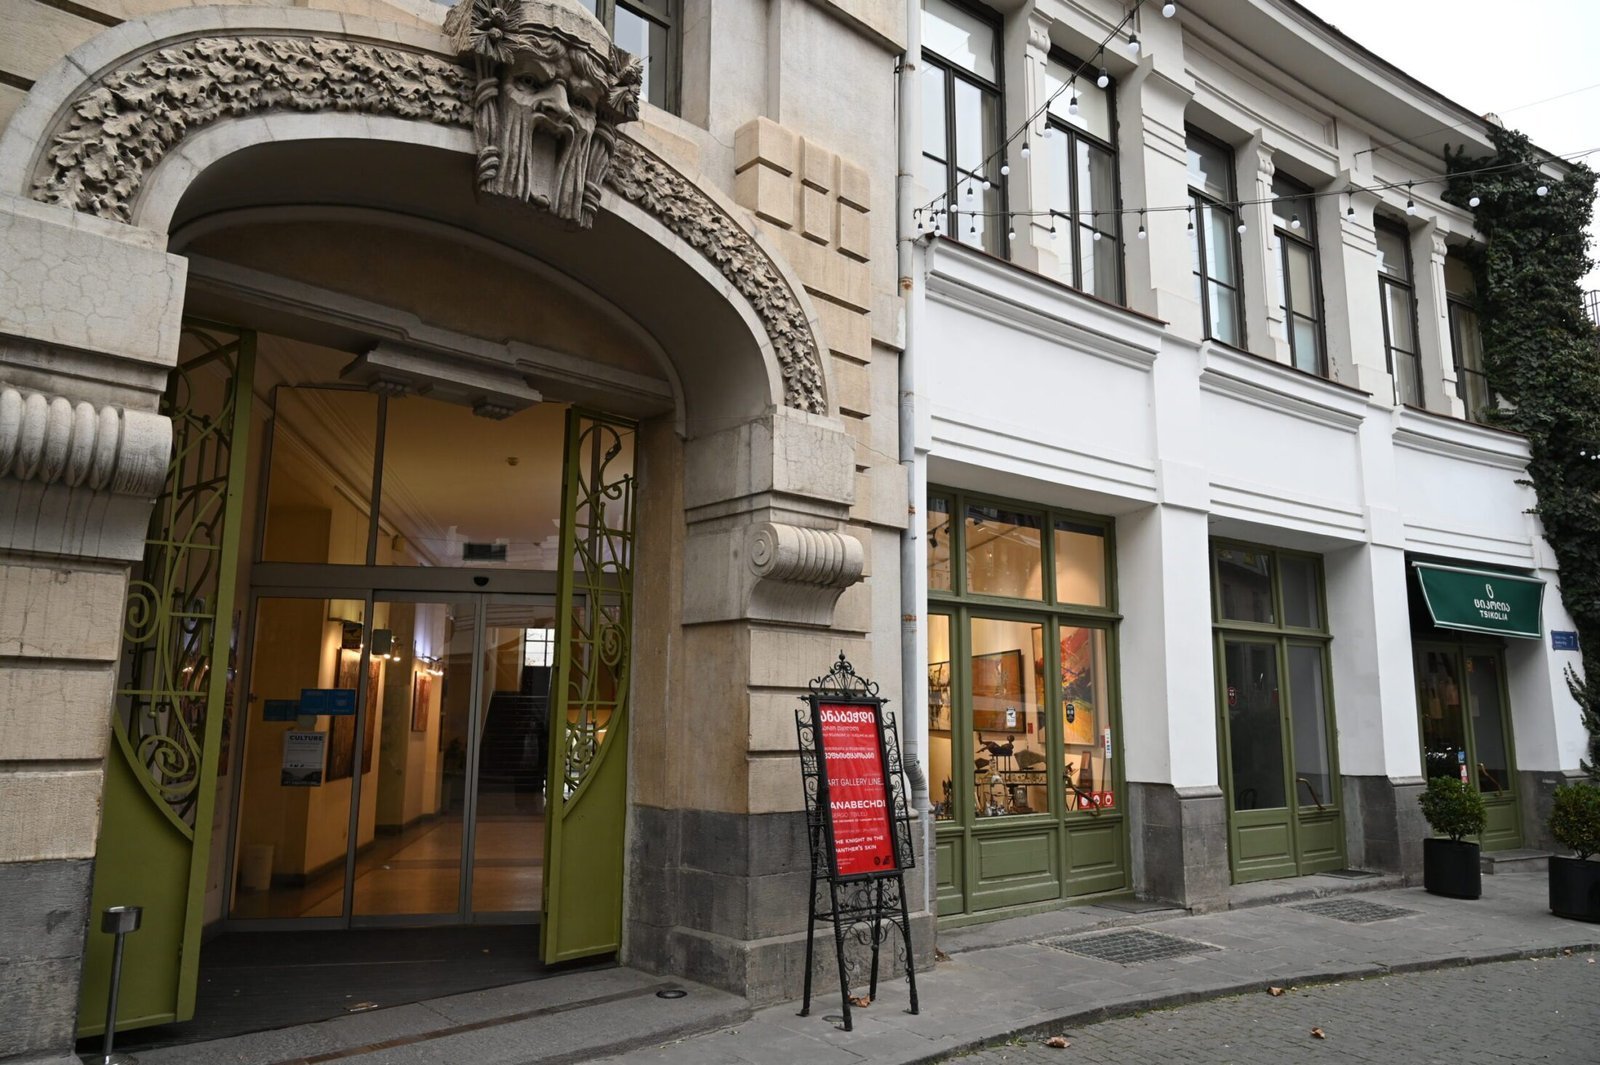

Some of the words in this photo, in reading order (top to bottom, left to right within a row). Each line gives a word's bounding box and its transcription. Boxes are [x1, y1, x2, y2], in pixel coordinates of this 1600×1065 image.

[1479, 610, 1508, 621] TSIKOLIA
[820, 709, 875, 724] ანაბეჭდი
[840, 777, 867, 787] GALLERY
